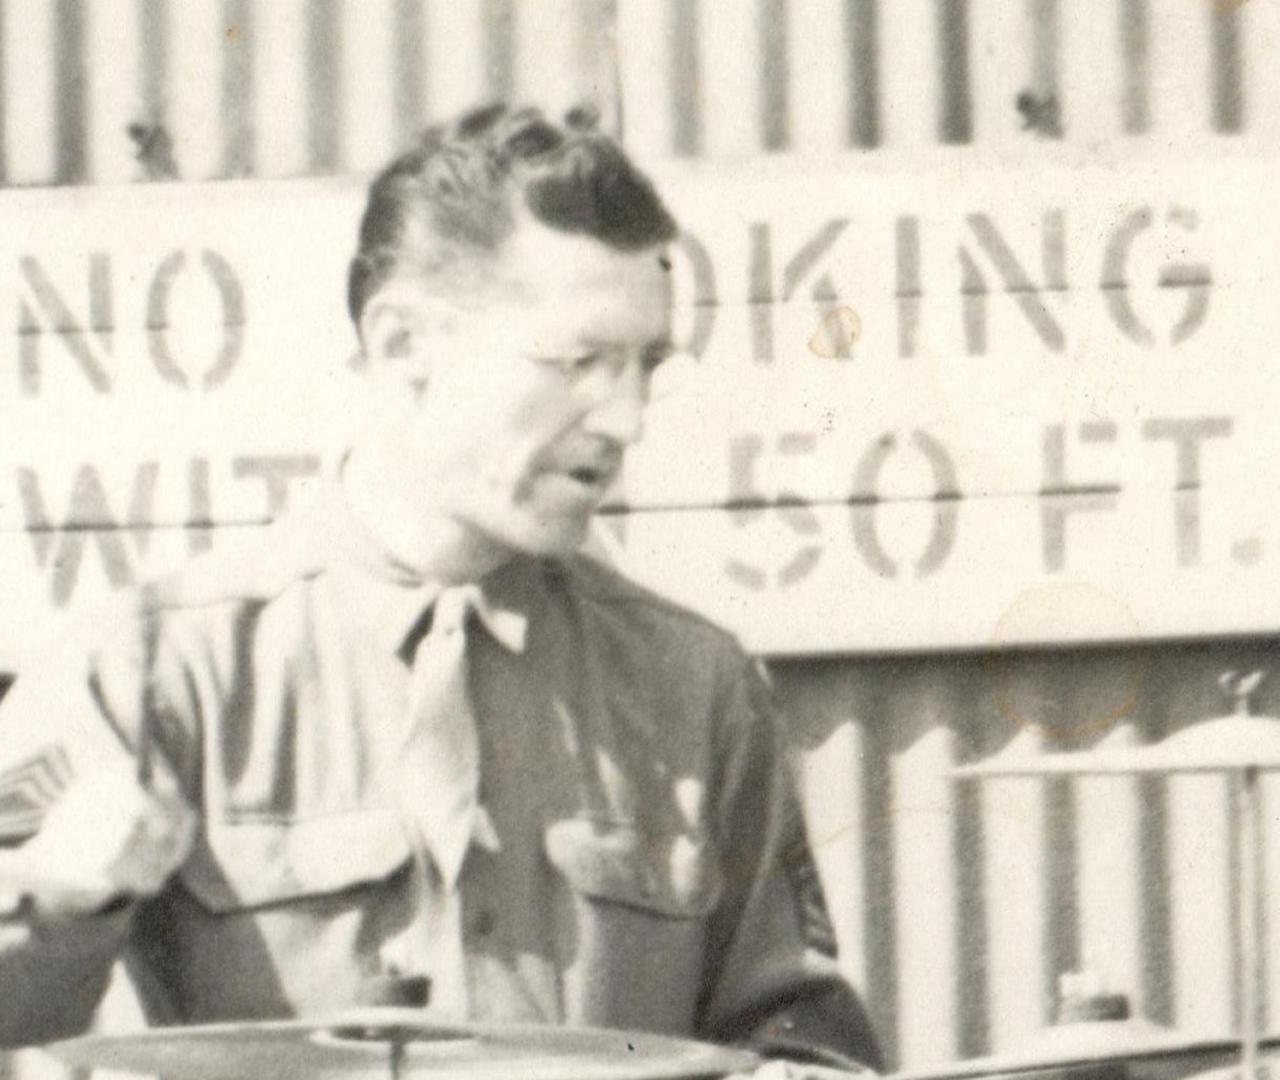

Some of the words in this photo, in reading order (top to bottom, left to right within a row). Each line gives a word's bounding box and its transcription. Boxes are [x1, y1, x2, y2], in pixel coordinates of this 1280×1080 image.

[16, 248, 247, 395] NO
[725, 428, 963, 591] 50
[1039, 416, 1266, 574] FT.
